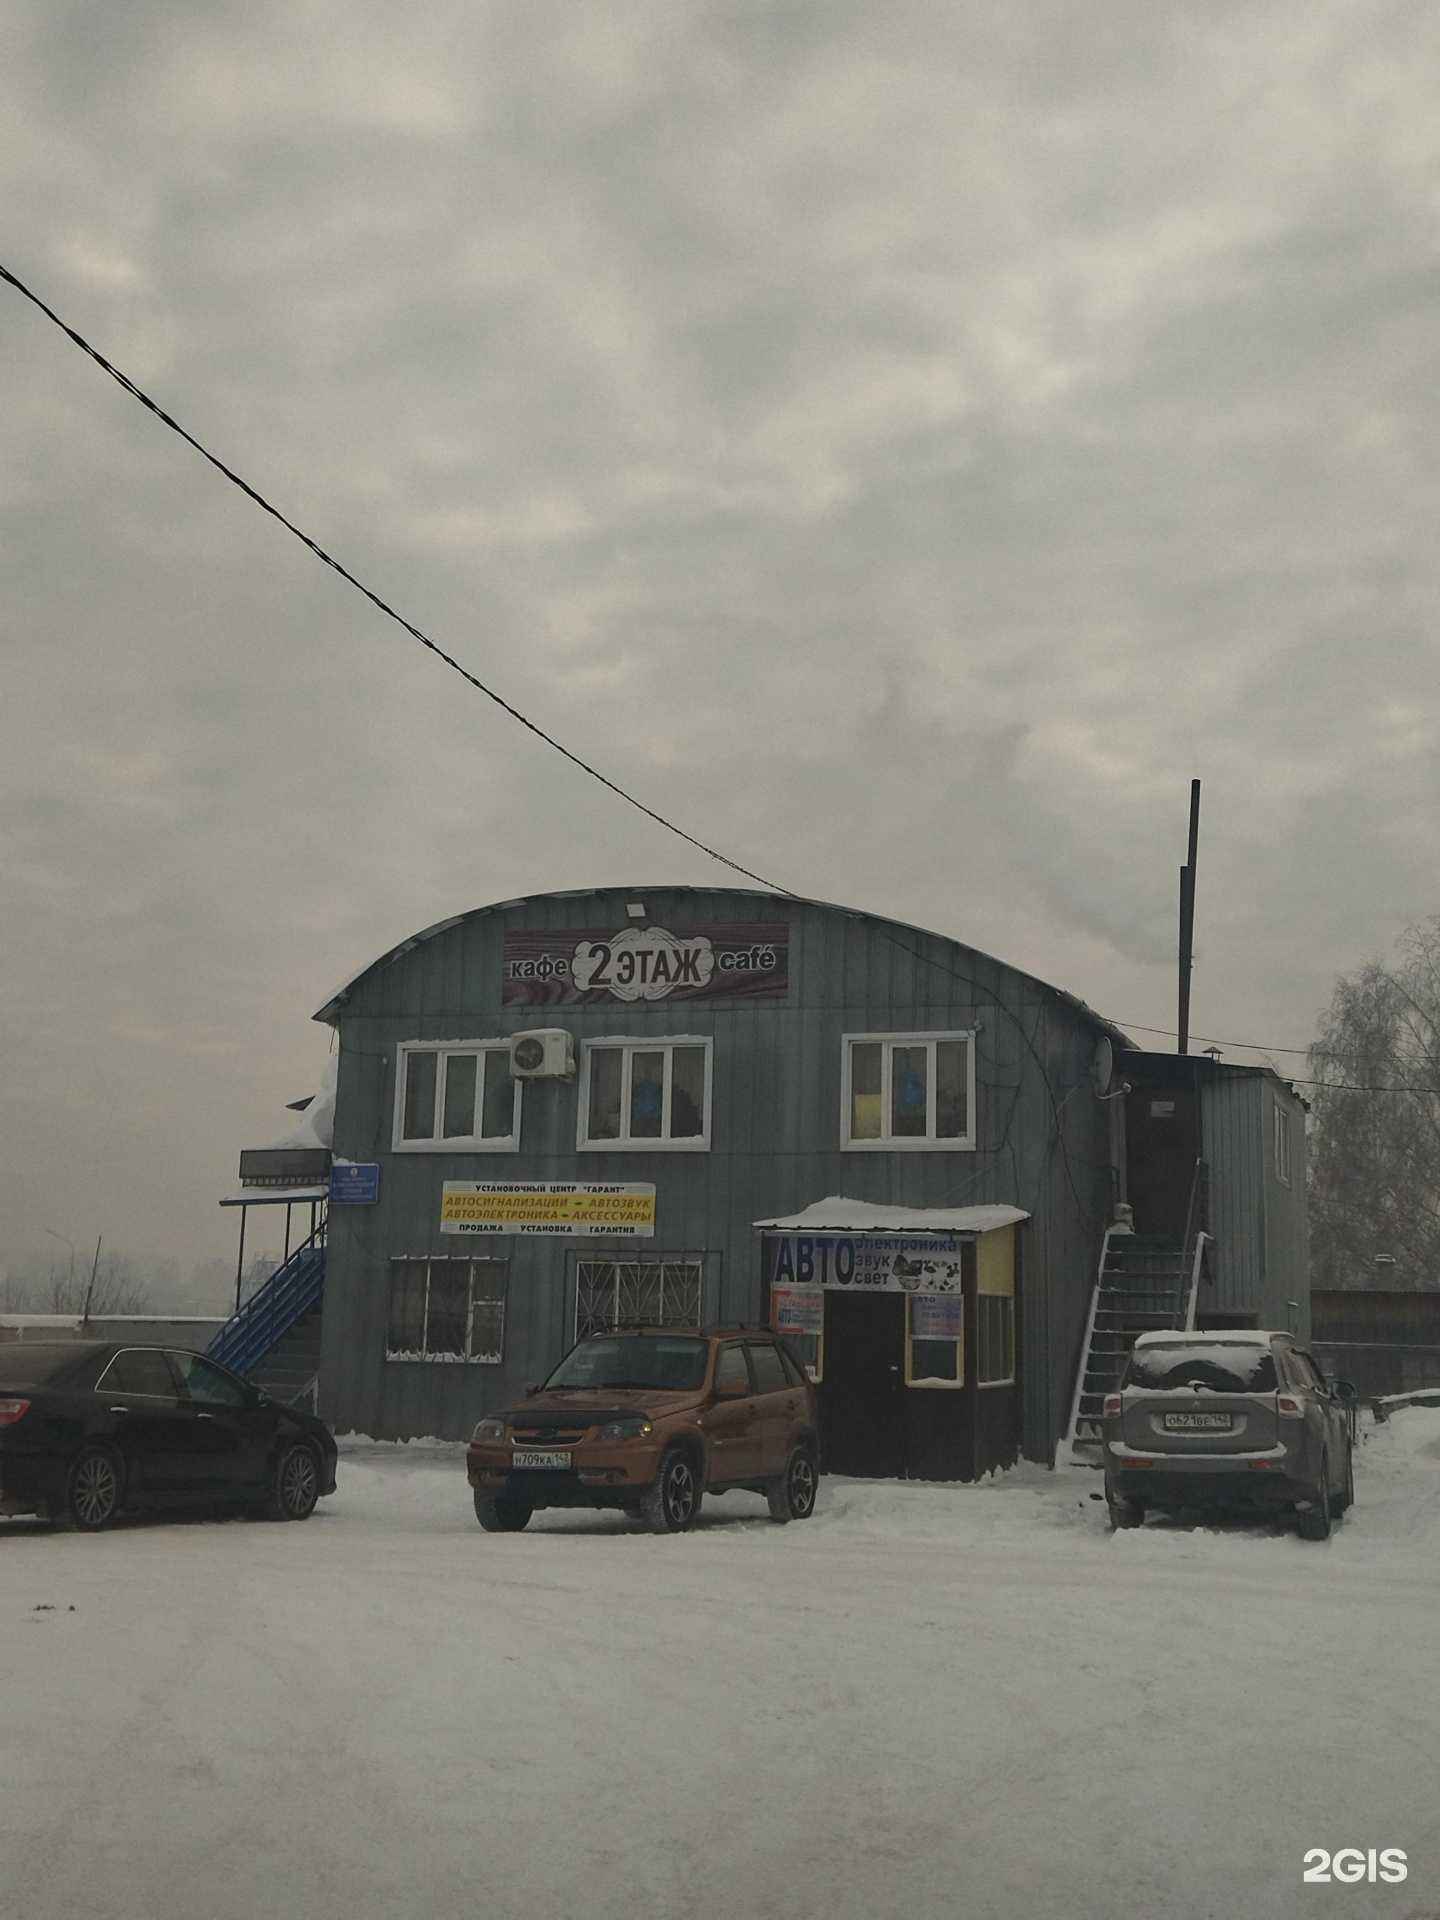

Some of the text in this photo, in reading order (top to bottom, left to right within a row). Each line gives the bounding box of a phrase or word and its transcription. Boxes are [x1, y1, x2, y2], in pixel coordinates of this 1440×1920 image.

[719, 944, 776, 971] café
[511, 945, 702, 986] кафе 2 ЭТАЖ
[475, 1185, 546, 1193] УСТАНОВОЧНЫЙ
[550, 1185, 577, 1194] ЦЕНТР
[589, 1199, 650, 1209] АВТОЗВУК
[445, 1209, 651, 1221] АВТОЭЛЕКТРОНИКА АКСЕССУАРЫ
[459, 1224, 635, 1234] ПРОДАЖА УСТАНОВКА ГАРАНТИЯ
[775, 1236, 855, 1285] АВТО
[855, 1254, 890, 1270] звук
[855, 1271, 890, 1285] свет
